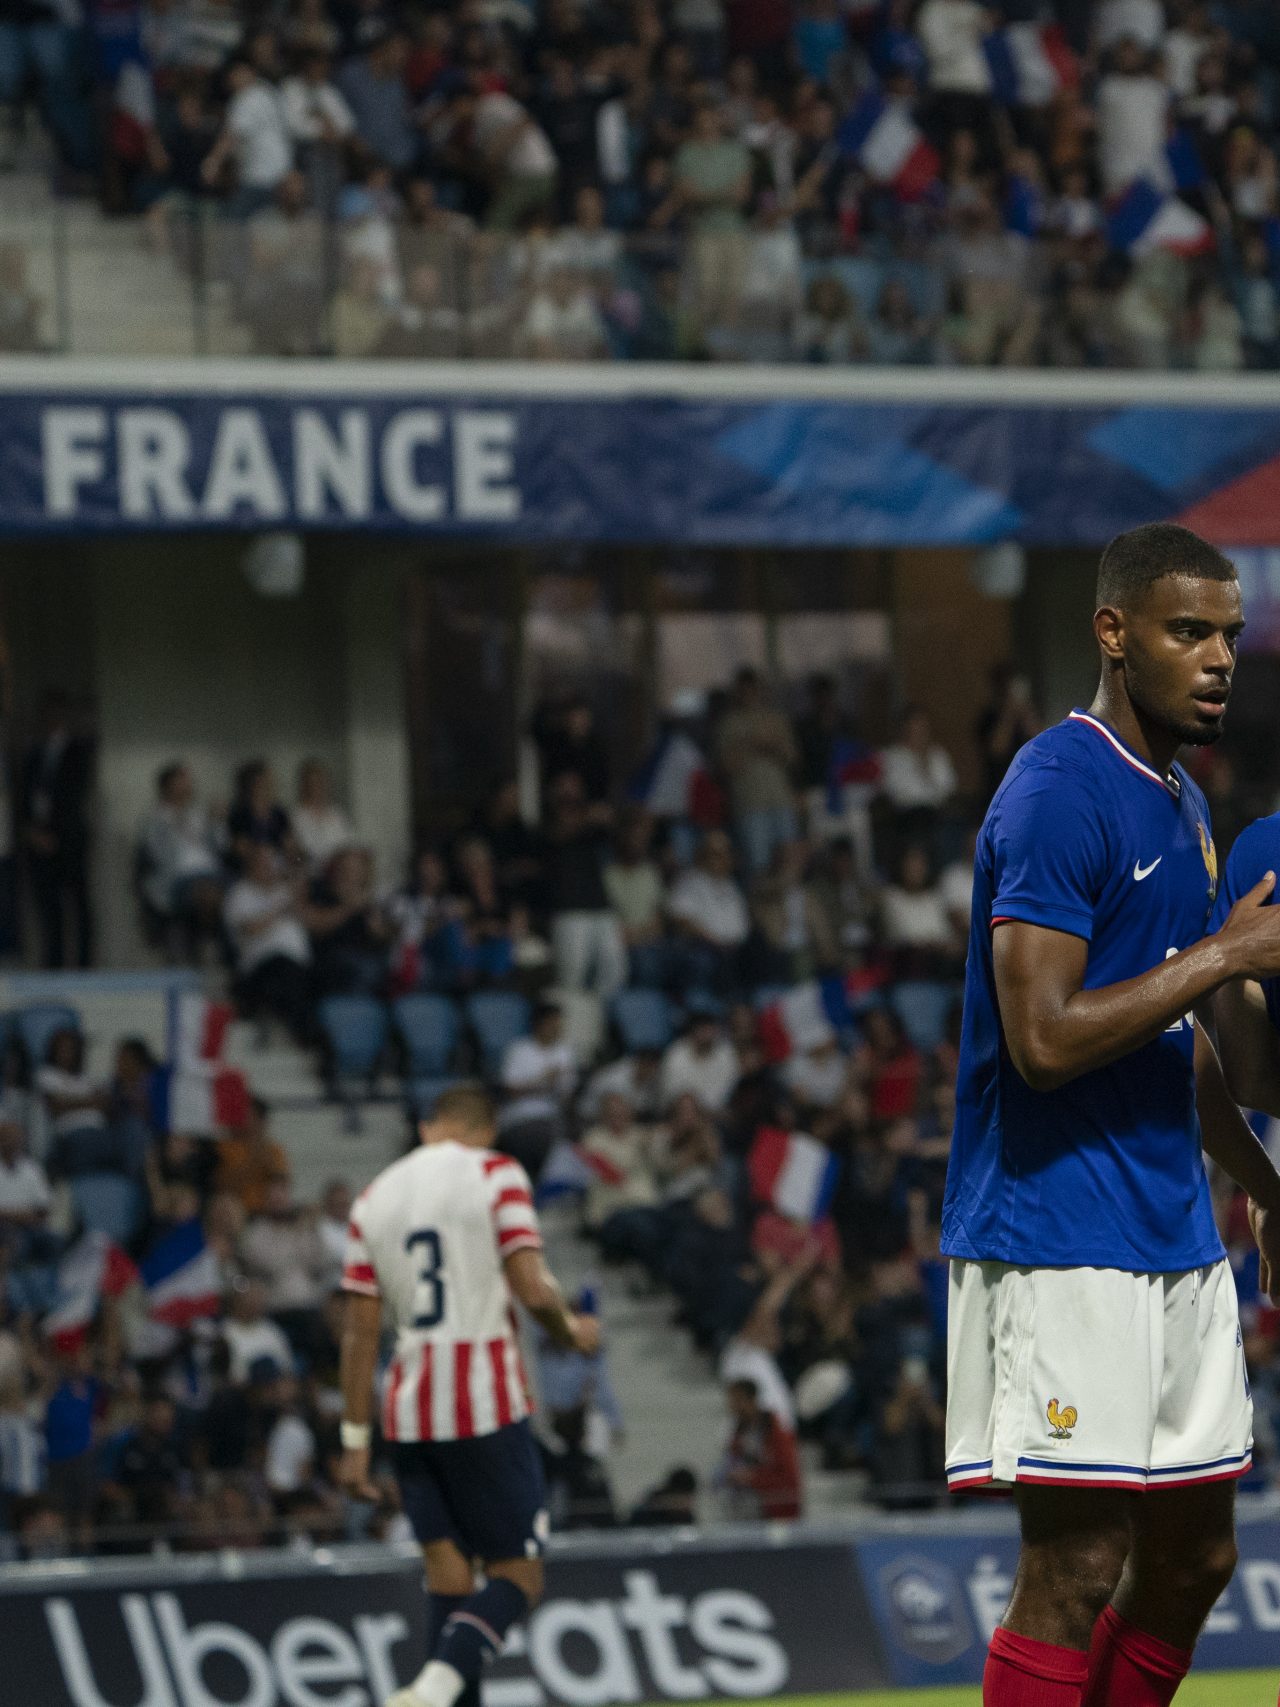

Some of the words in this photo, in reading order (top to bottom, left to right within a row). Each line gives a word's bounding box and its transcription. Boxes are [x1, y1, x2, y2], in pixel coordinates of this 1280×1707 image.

[41, 406, 522, 522] FRANCE
[406, 1227, 445, 1328] 3
[44, 1592, 406, 1707] Uber
